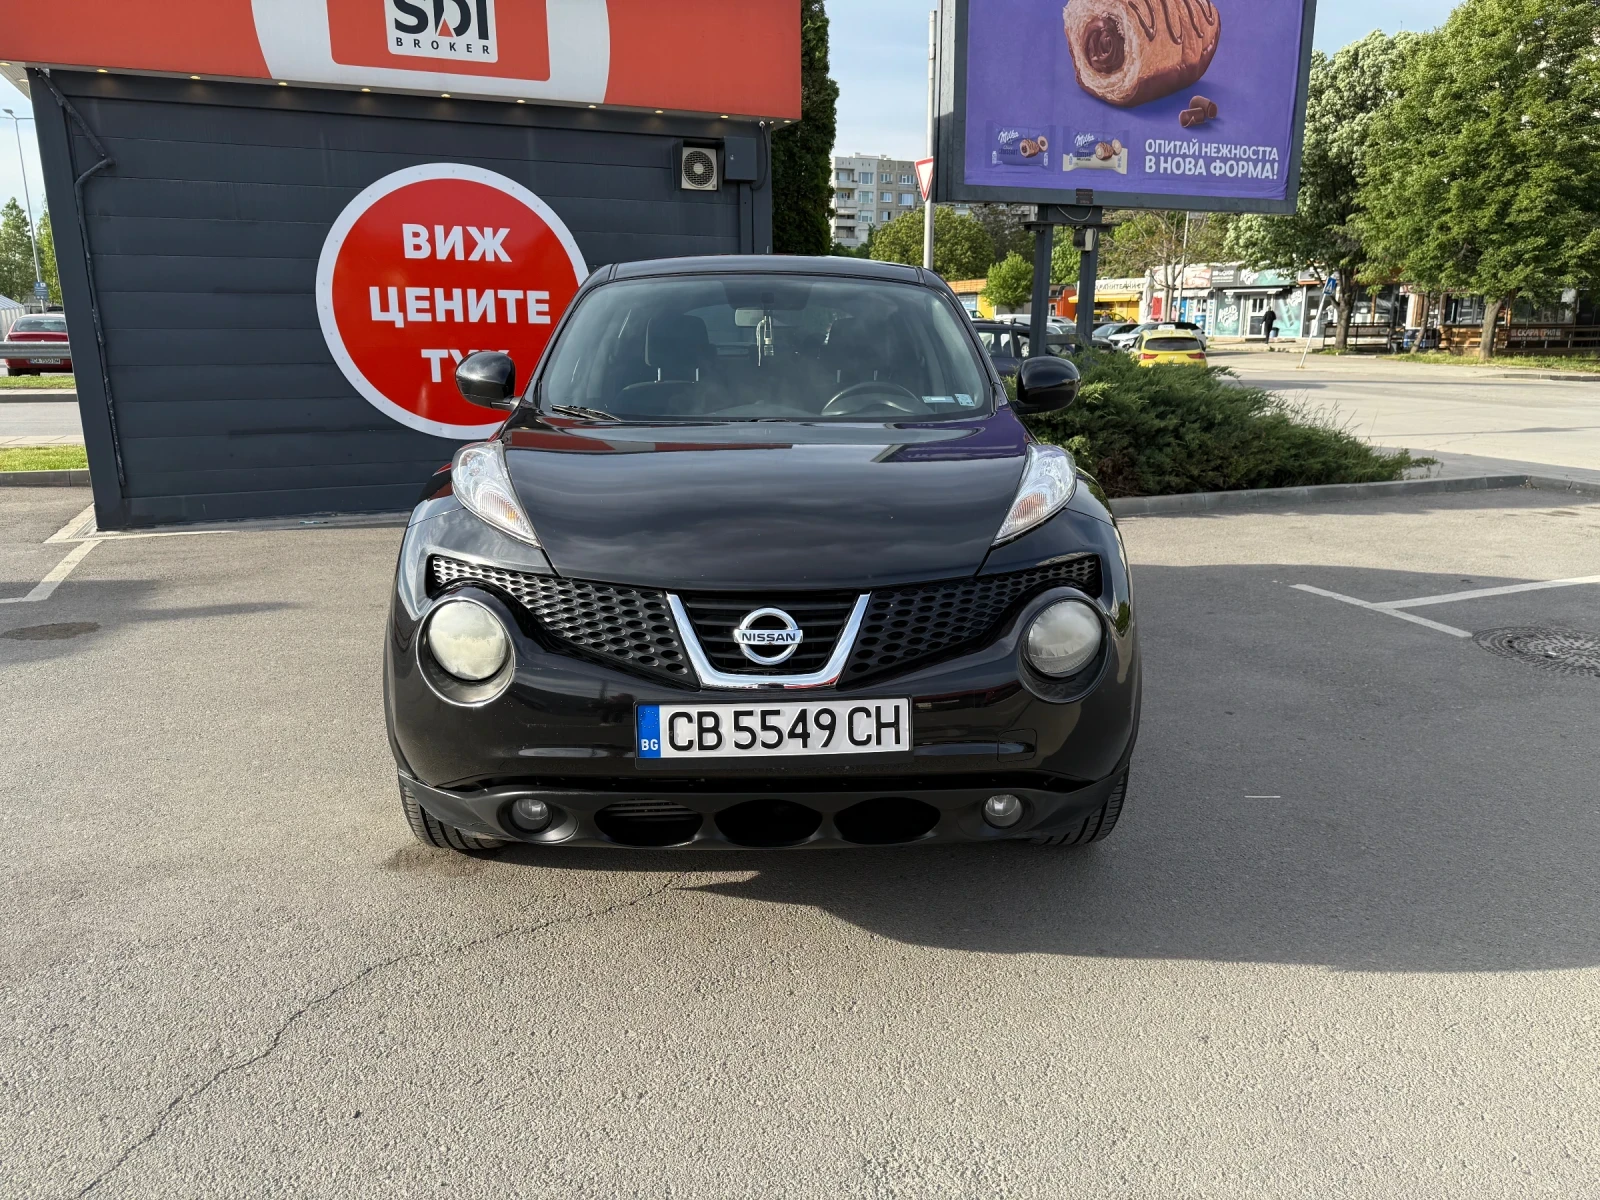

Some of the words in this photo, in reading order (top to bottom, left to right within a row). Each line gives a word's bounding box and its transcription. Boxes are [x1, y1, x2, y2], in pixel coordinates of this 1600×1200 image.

[395, 37, 490, 54] BROKER
[997, 130, 1020, 143] Milka
[1074, 133, 1095, 146] Milka
[1145, 138, 1199, 155] ОПИТАЙ
[1201, 143, 1279, 160] НЕЖНОСТТА
[1145, 155, 1156, 173] В
[1160, 156, 1207, 176] НОВА
[1210, 159, 1279, 179] ФОРМА!
[402, 223, 512, 263] ВИЖ
[369, 286, 551, 328] ЦЕНИТЕ
[741, 632, 796, 642] NISSAN
[667, 710, 723, 751] CB
[732, 707, 837, 750] 5549
[847, 704, 901, 747] CH
[641, 739, 659, 750] BG
